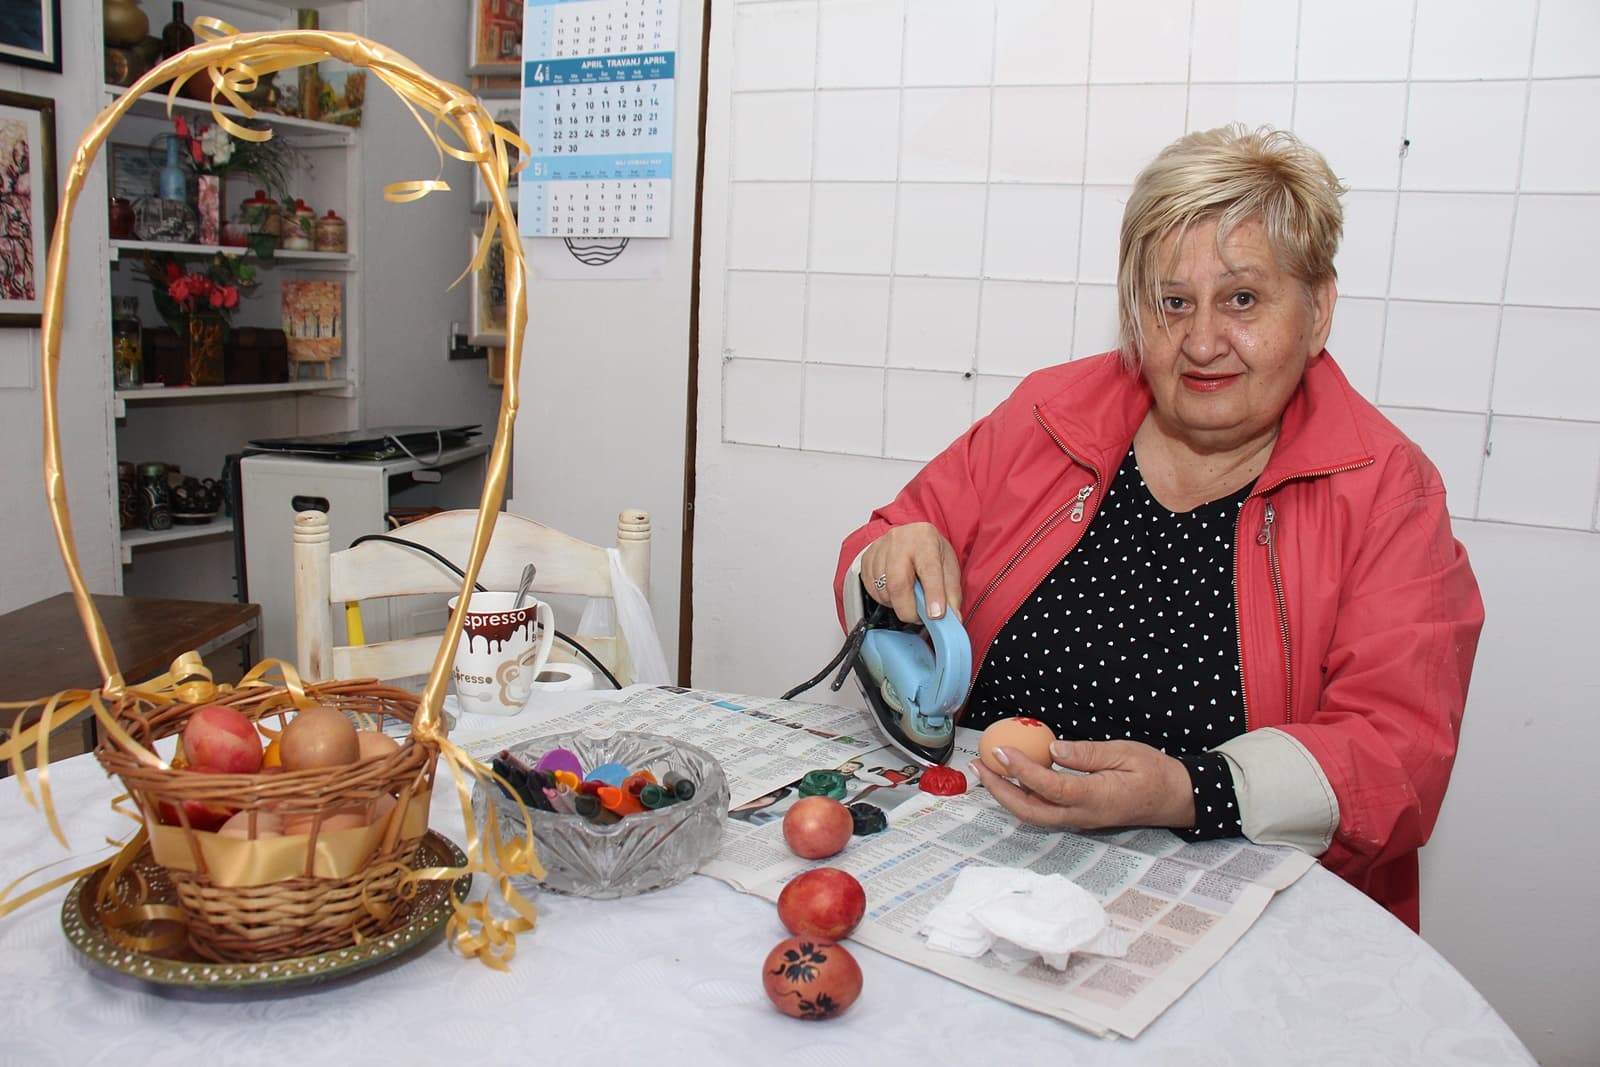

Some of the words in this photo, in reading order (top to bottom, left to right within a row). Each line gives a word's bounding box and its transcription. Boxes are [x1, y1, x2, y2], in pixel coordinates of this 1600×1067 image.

[581, 60, 604, 69] APRIL
[607, 58, 640, 68] TRAVANJ
[643, 56, 667, 65] APRIL
[534, 63, 544, 83] 4
[556, 88, 560, 97] 1
[571, 88, 577, 97] 2
[587, 87, 593, 96] 3
[603, 86, 609, 94] 4
[619, 85, 625, 94] 5
[636, 84, 641, 93] 6
[652, 83, 657, 92] 7
[556, 103, 561, 112] 8
[571, 102, 577, 110] 9
[585, 101, 595, 110] 10
[601, 100, 610, 109] 11
[618, 99, 627, 109] 12
[634, 99, 643, 108] 13
[650, 98, 659, 106] 14
[554, 116, 563, 125] 15
[569, 116, 578, 125] 16
[585, 115, 594, 124] 17
[601, 115, 610, 123] 18
[617, 114, 626, 122] 19
[632, 113, 643, 122] 20
[648, 112, 658, 121] 21
[553, 130, 563, 140] 22
[568, 130, 578, 139] 23
[584, 130, 594, 138] 24
[600, 128, 610, 138] 25
[616, 128, 626, 137] 26
[632, 127, 642, 137] 27
[648, 126, 658, 136] 28
[553, 145, 562, 153] 29
[568, 144, 578, 153] 30
[464, 611, 526, 629] spresso
